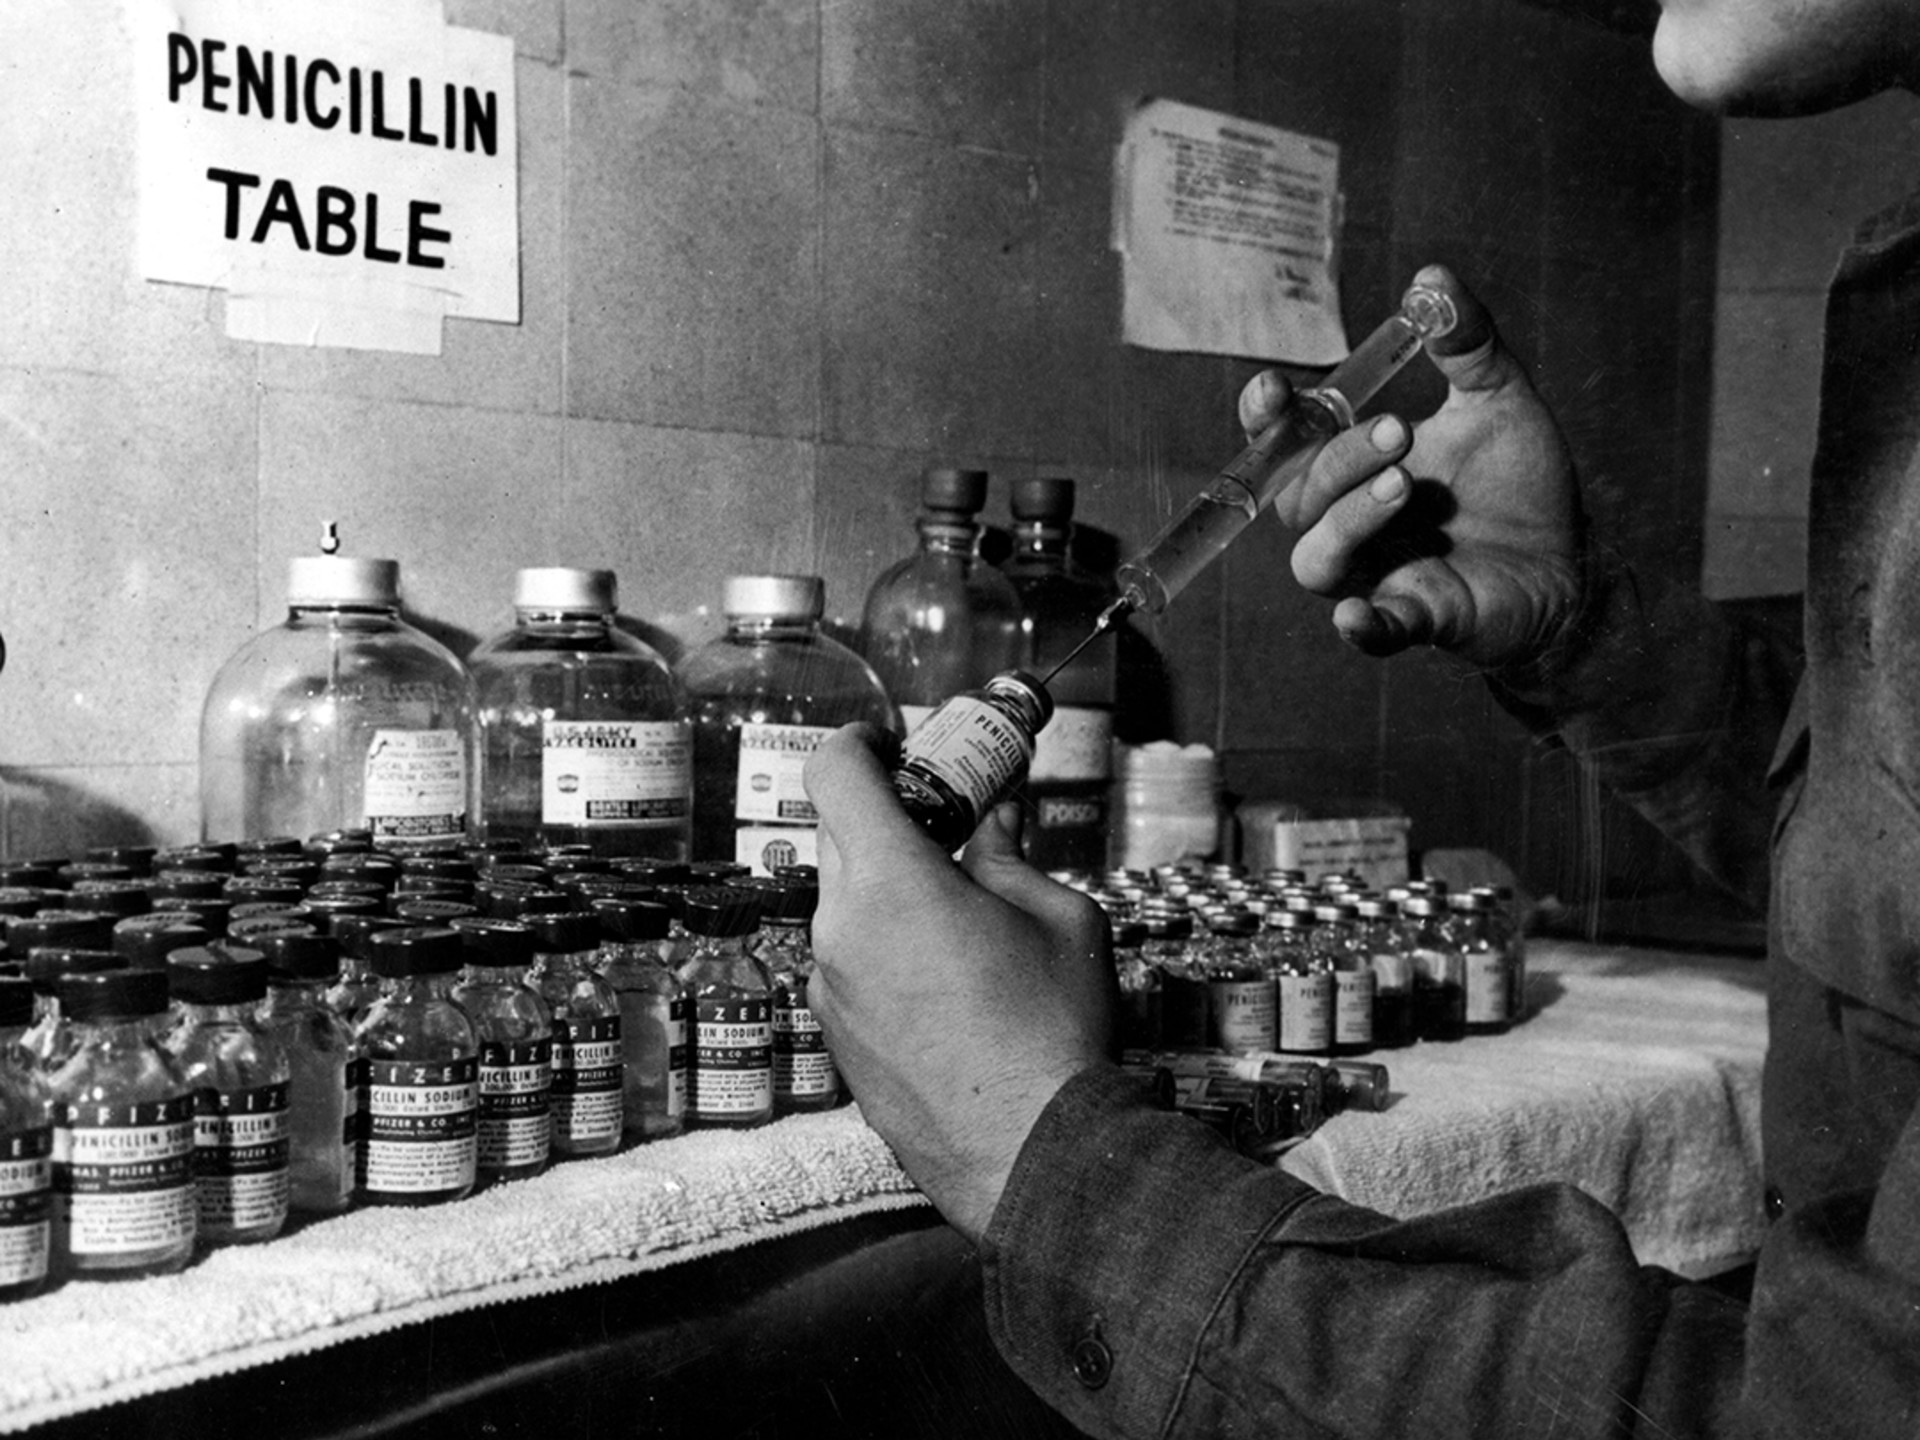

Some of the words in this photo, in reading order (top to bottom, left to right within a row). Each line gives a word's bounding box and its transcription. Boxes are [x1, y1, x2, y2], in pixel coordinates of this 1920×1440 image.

[168, 32, 497, 156] PENICILLIN
[206, 167, 451, 269] TABLE
[723, 1026, 765, 1039] SODIUM
[424, 1087, 471, 1104] SODIUM
[373, 1116, 412, 1129] PFIZER
[109, 1164, 153, 1178] PFIZER
